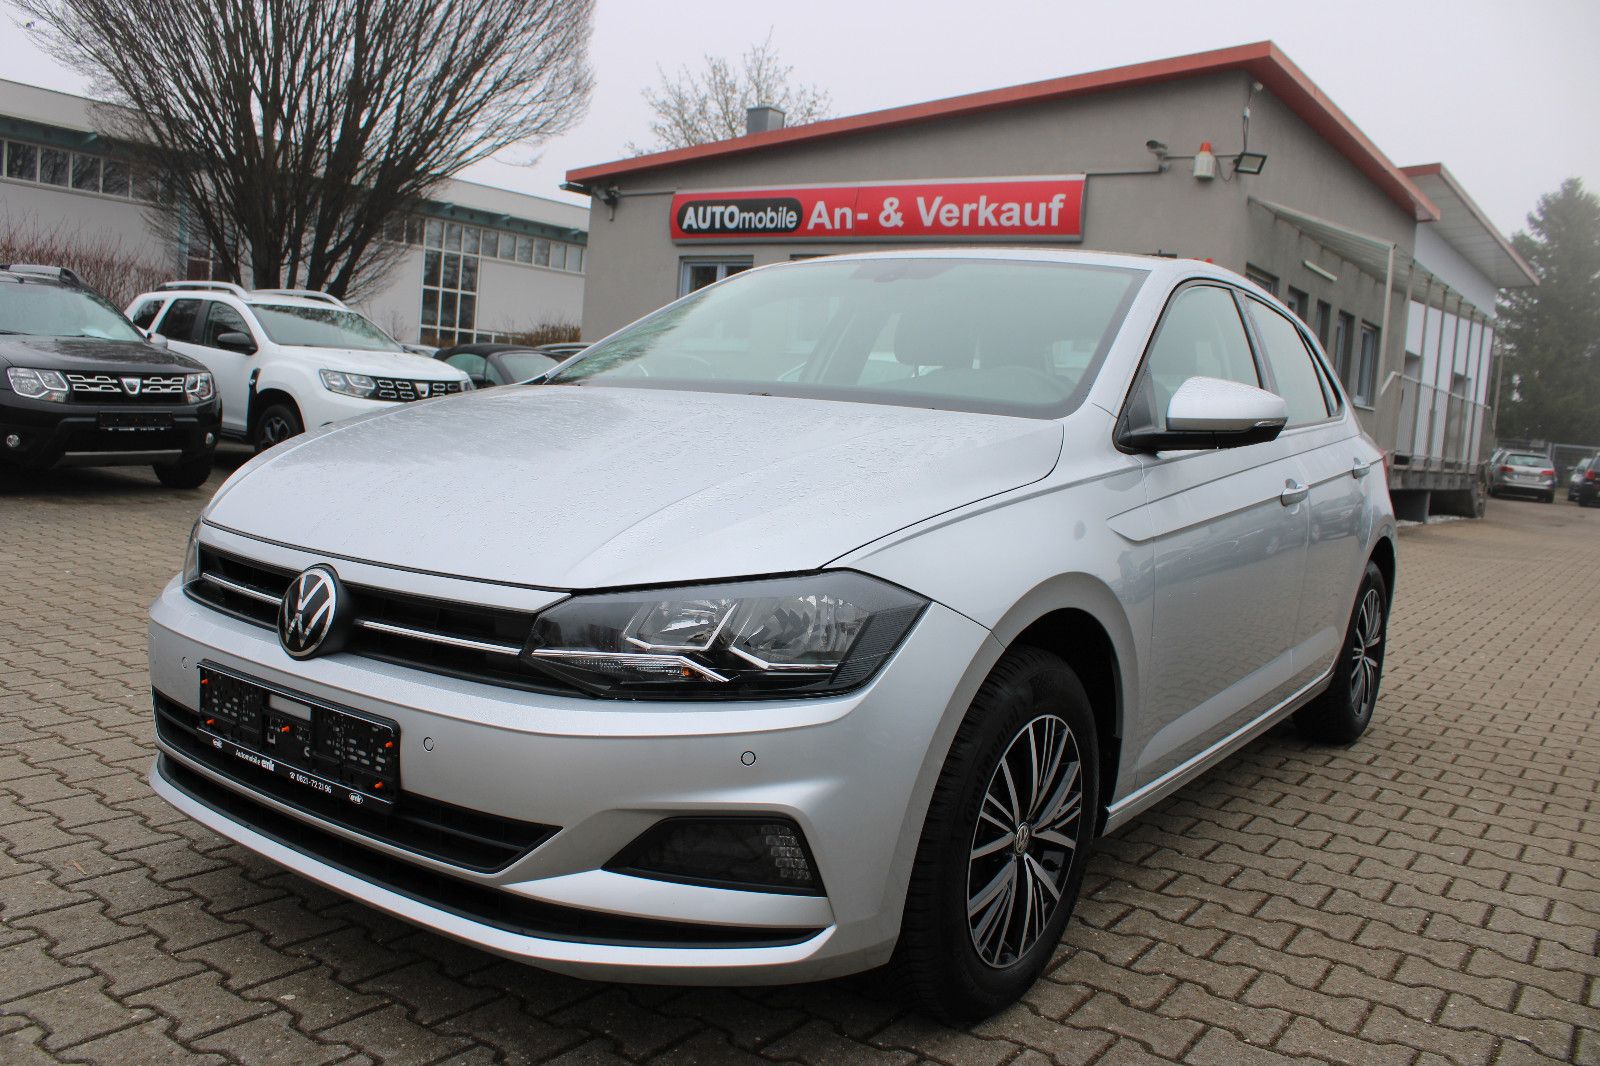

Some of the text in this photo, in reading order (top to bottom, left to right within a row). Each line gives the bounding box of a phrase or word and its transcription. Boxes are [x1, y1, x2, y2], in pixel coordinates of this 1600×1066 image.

[681, 193, 1067, 230] AUTOmobile An- & Verkauf
